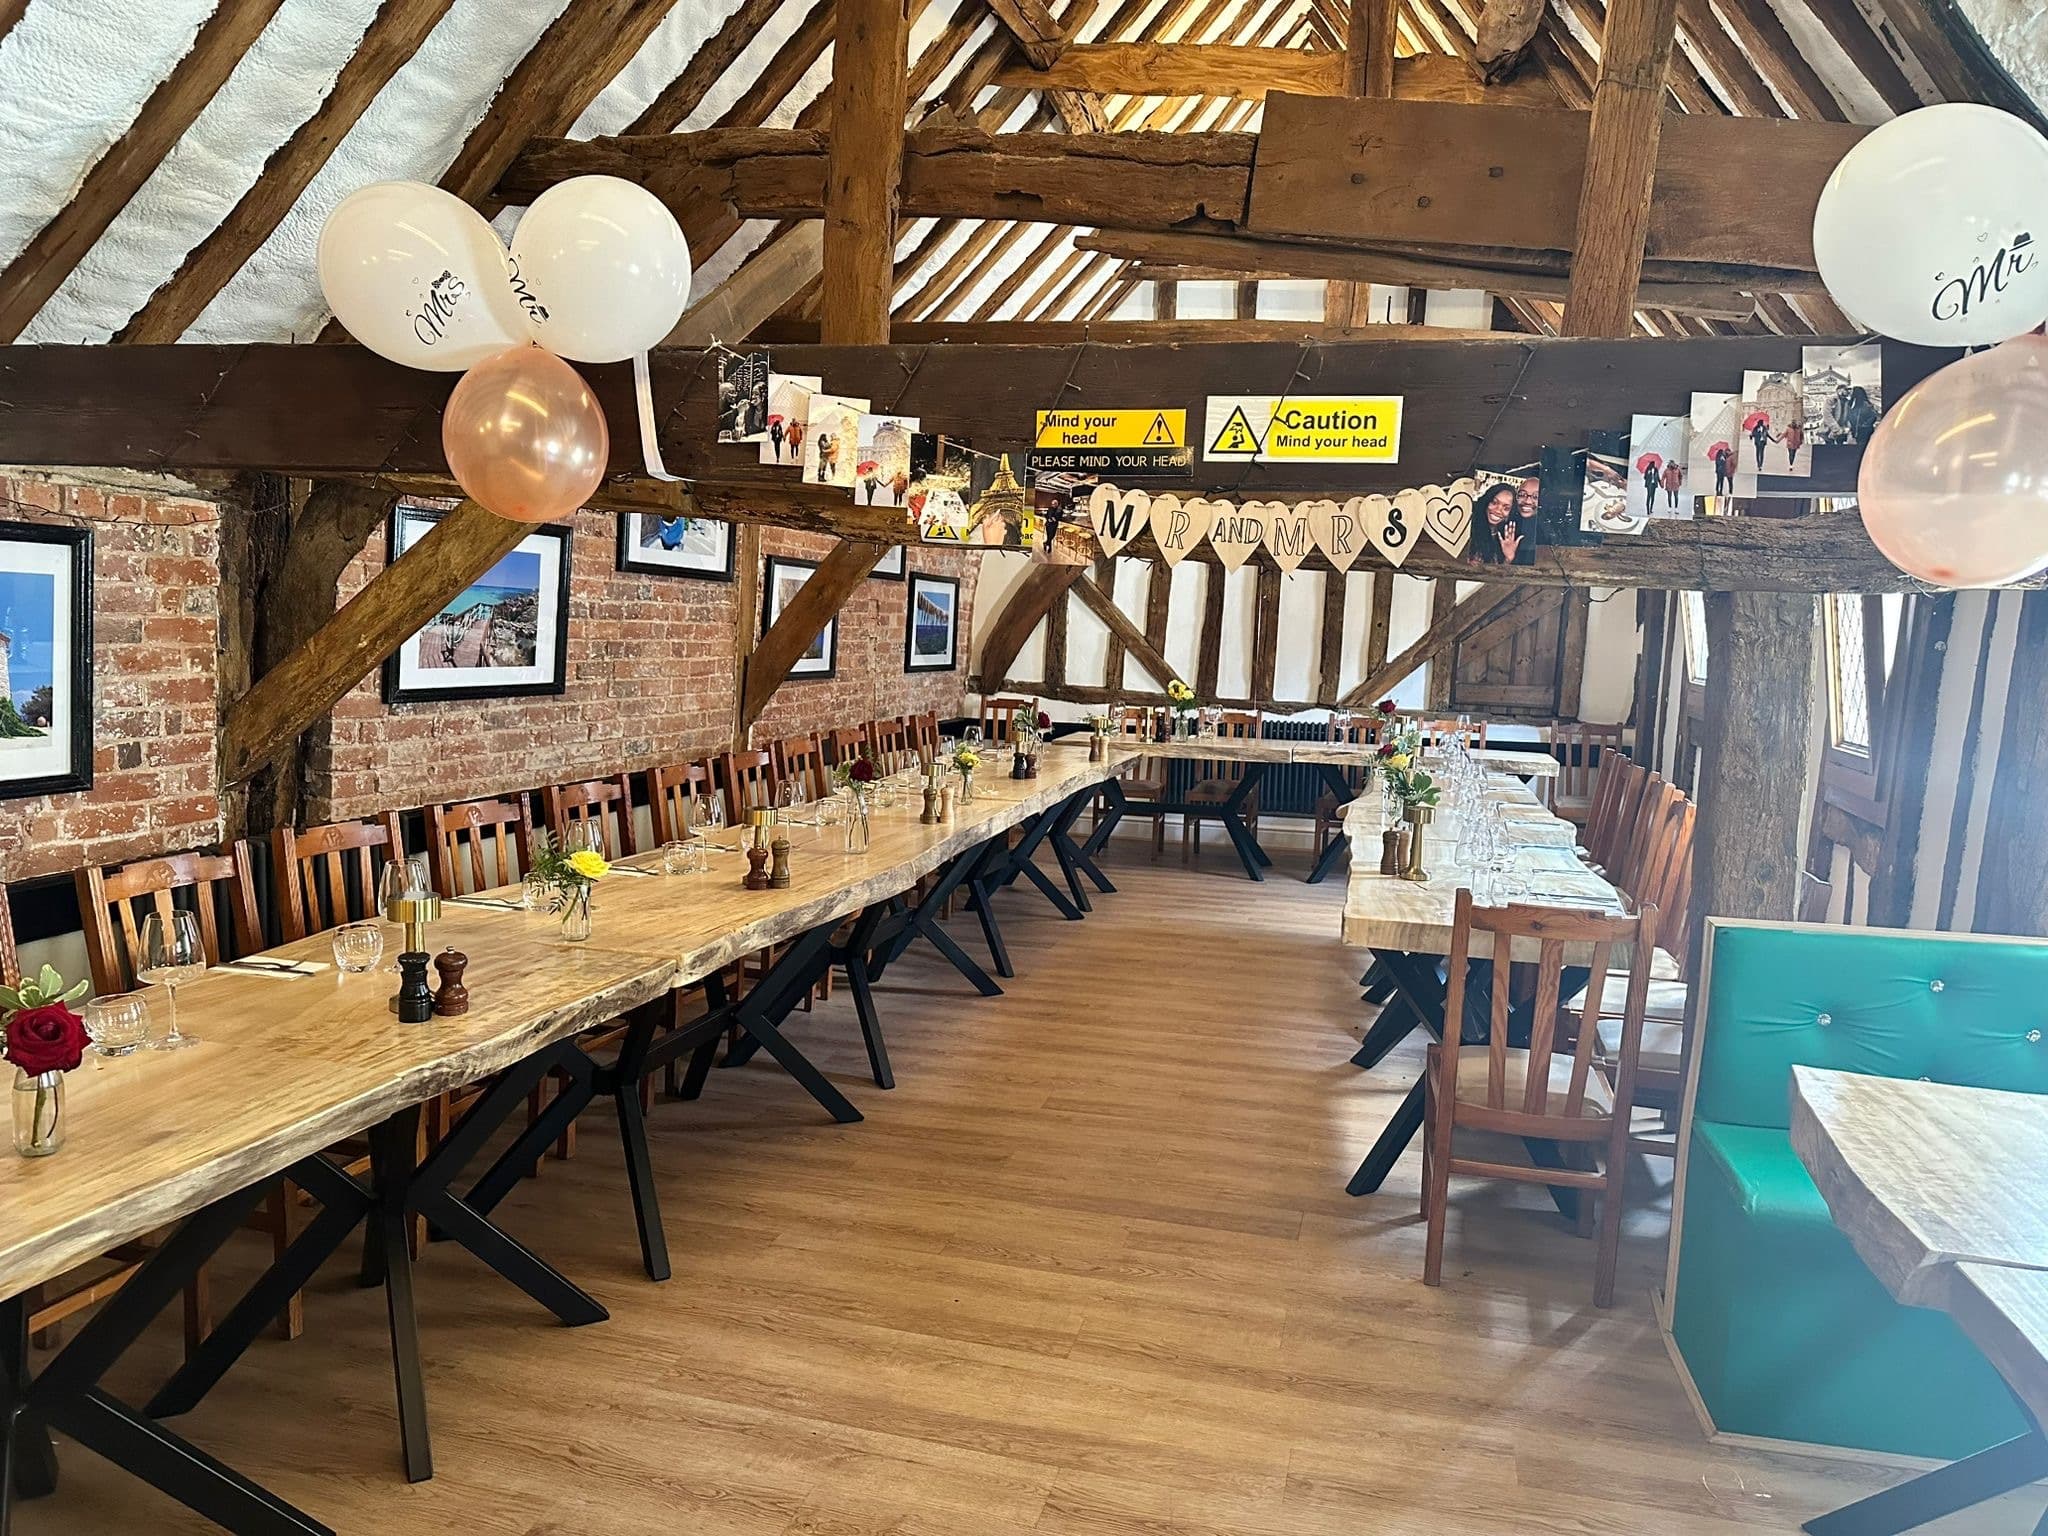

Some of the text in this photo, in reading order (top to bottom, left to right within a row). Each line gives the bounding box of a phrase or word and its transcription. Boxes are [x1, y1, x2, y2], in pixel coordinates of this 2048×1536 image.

[508, 257, 542, 324] Mr
[1932, 248, 2034, 320] Mr
[414, 276, 465, 345] Mrs
[1044, 414, 1117, 430] Mind your
[1286, 410, 1377, 430] Caution
[1062, 432, 1098, 445] head
[1276, 435, 1388, 450] Mind your head
[1031, 455, 1187, 467] PLEASE MIND YOUR HEAD
[1212, 517, 1263, 544] AND
